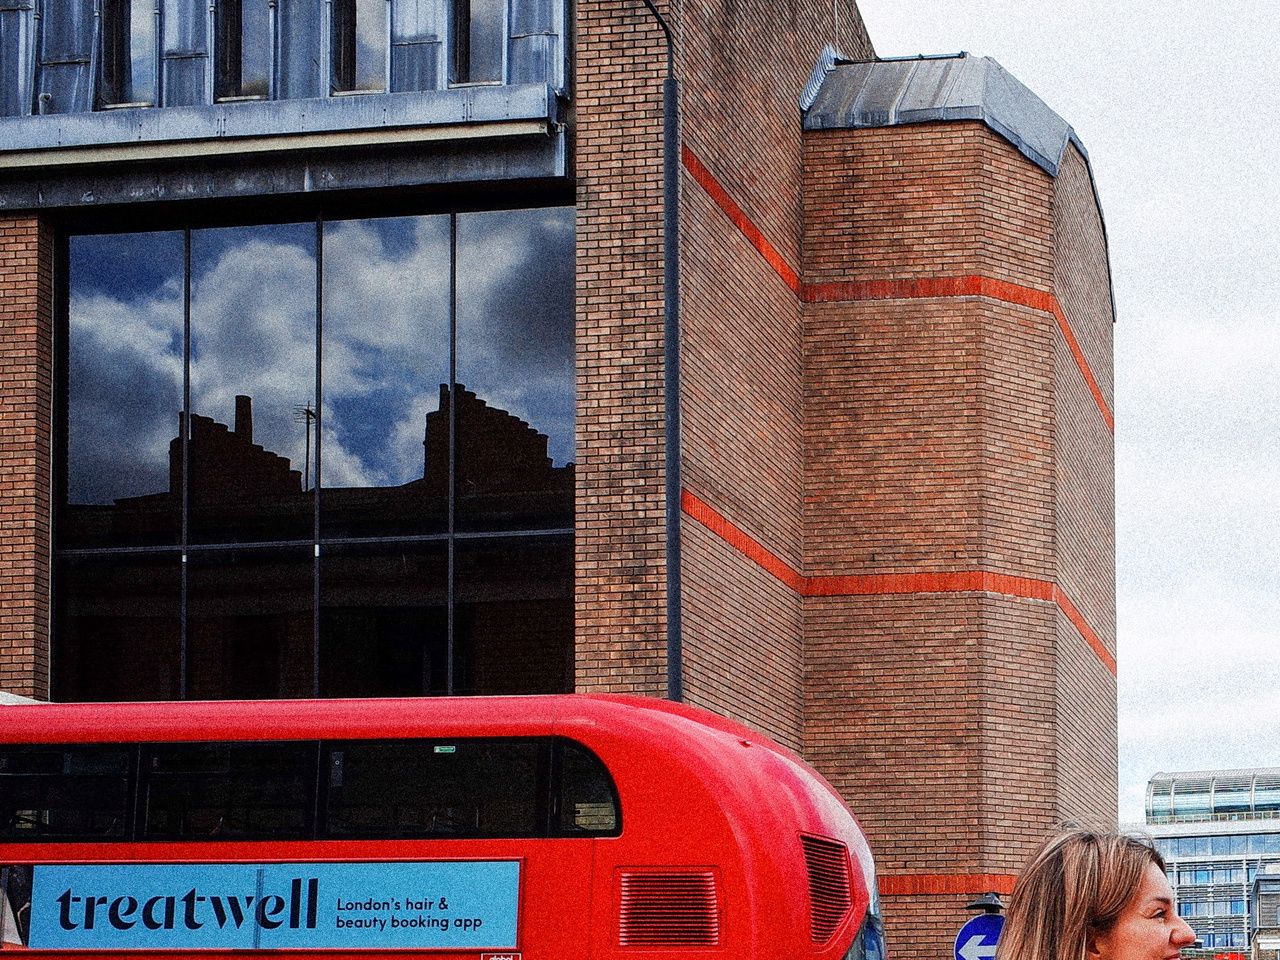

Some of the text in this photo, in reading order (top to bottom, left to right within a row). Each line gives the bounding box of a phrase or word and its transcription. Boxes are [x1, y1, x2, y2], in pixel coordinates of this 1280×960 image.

[55, 878, 319, 931] treatwell
[337, 897, 449, 911] London's hair &
[336, 915, 483, 932] beauty booking app
